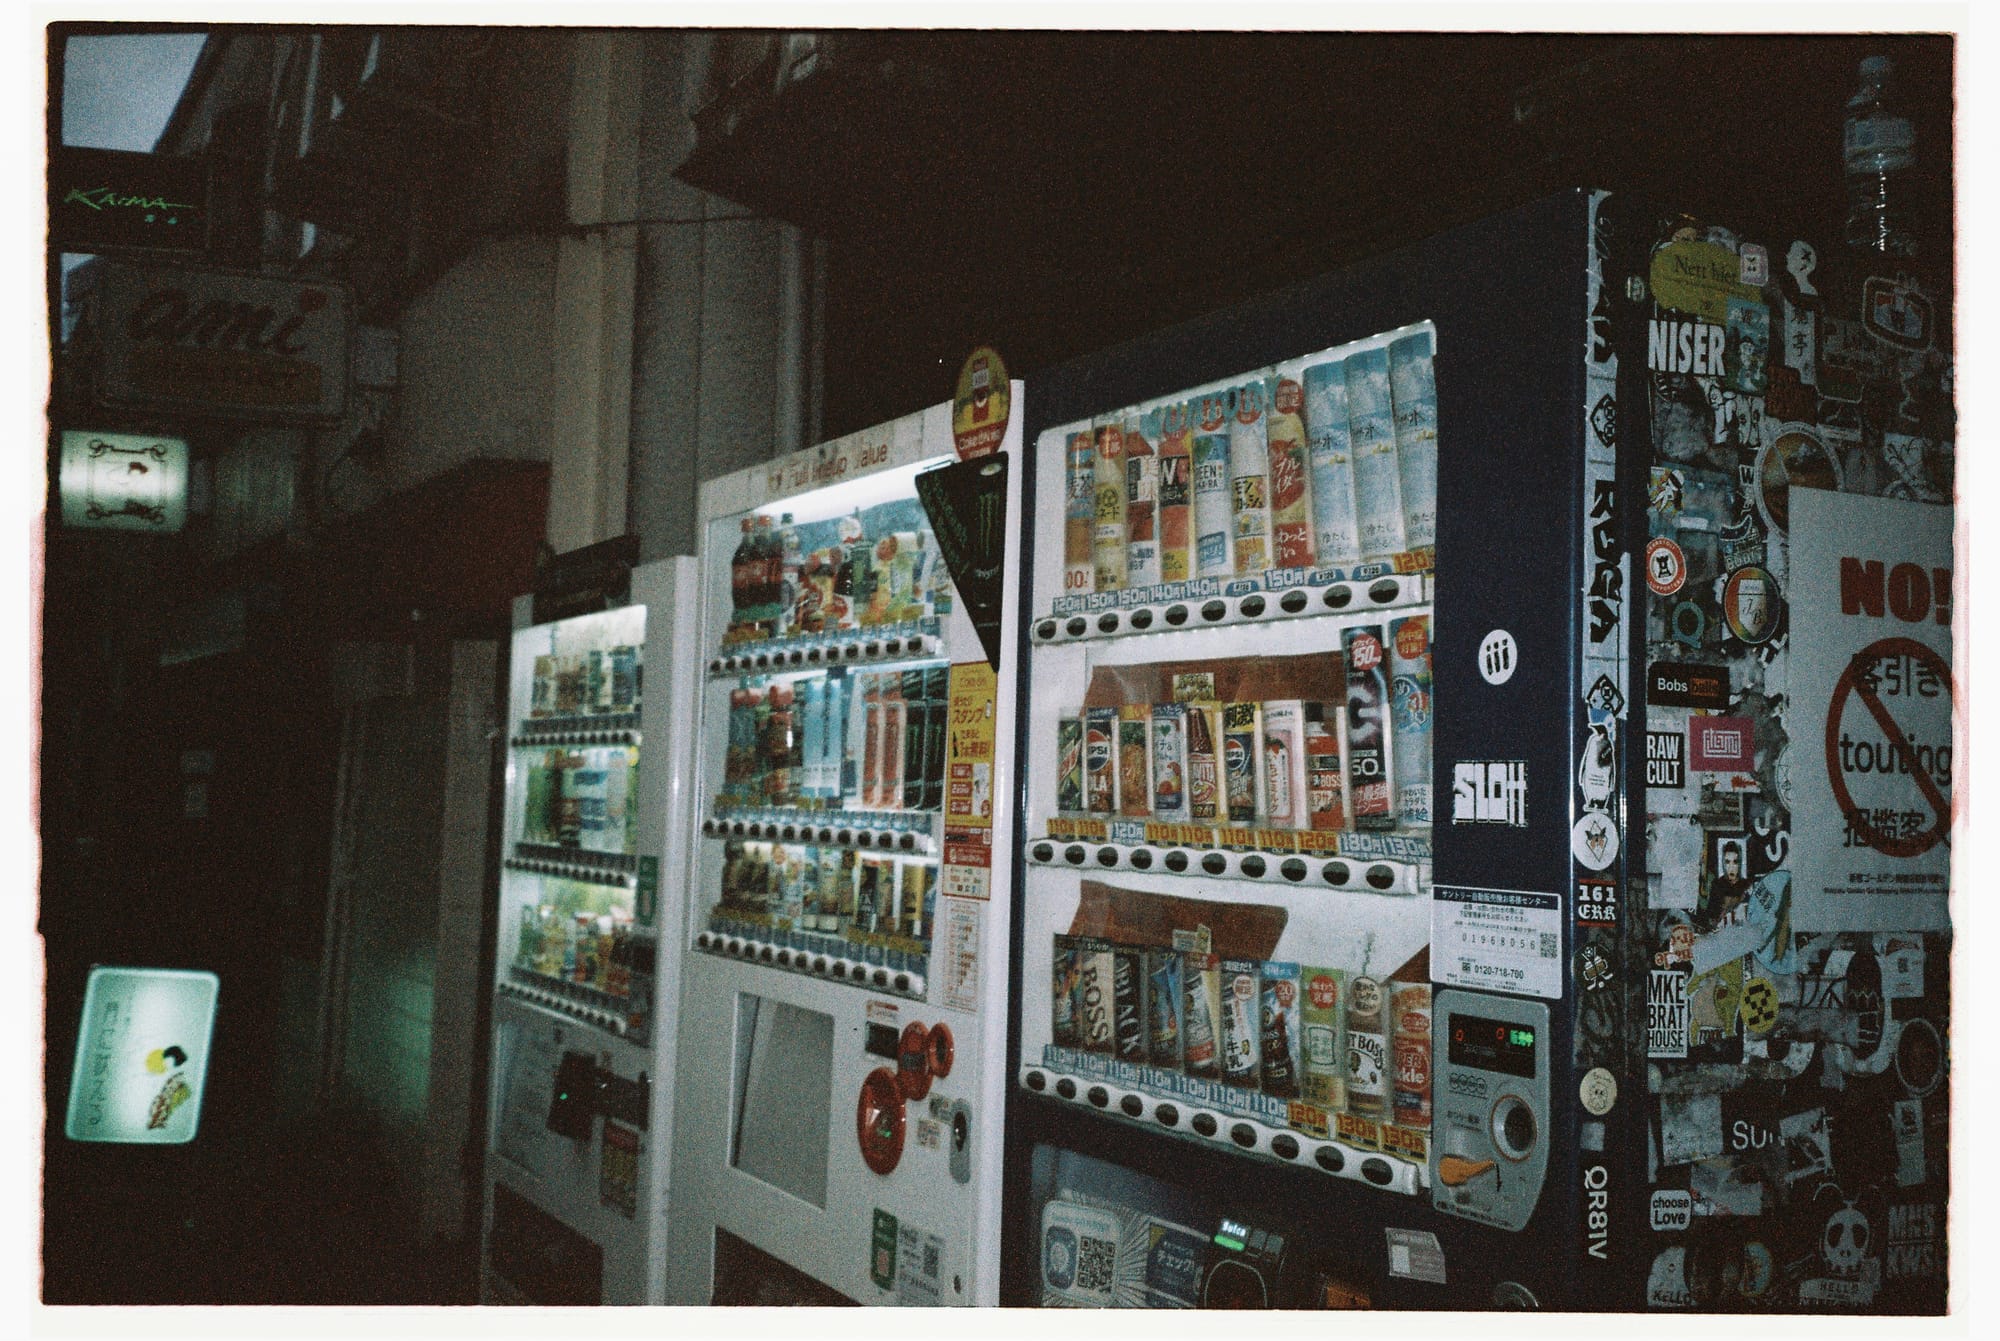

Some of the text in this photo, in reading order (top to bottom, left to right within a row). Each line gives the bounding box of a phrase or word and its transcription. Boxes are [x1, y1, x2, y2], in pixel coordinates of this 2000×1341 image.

[1673, 255, 1706, 279] Nett
[1647, 319, 1726, 378] NISER
[1185, 578, 1218, 598] 140円
[1267, 570, 1305, 589] 150円
[1656, 677, 1689, 693] Bobs
[1852, 653, 1940, 698] 客引き
[953, 708, 984, 725] スタンプ
[1646, 734, 1680, 760] RAW
[1839, 733, 1952, 787] touting
[1646, 760, 1681, 786] CULT
[1113, 821, 1144, 839] 120円
[1147, 823, 1178, 840] 110円
[1180, 825, 1213, 842] 110円
[1221, 828, 1256, 846] 110円
[1260, 831, 1296, 849] 110円
[1298, 832, 1337, 851] 120円
[1578, 884, 1617, 903] 161
[1474, 965, 1525, 981] 0120-718-700
[1647, 974, 1685, 1004] MKE
[1082, 964, 1109, 1043] BOSS
[1648, 1004, 1685, 1029] BRAT
[1648, 1029, 1685, 1048] HOUSE
[1174, 1073, 1207, 1096] 110円
[1209, 1082, 1245, 1106] 110円
[1250, 1091, 1287, 1117] 110円
[1288, 1102, 1327, 1125] 120円
[1584, 1165, 1609, 1260] QR81V
[1652, 1197, 1690, 1210] choose
[1654, 1210, 1687, 1226] Love
